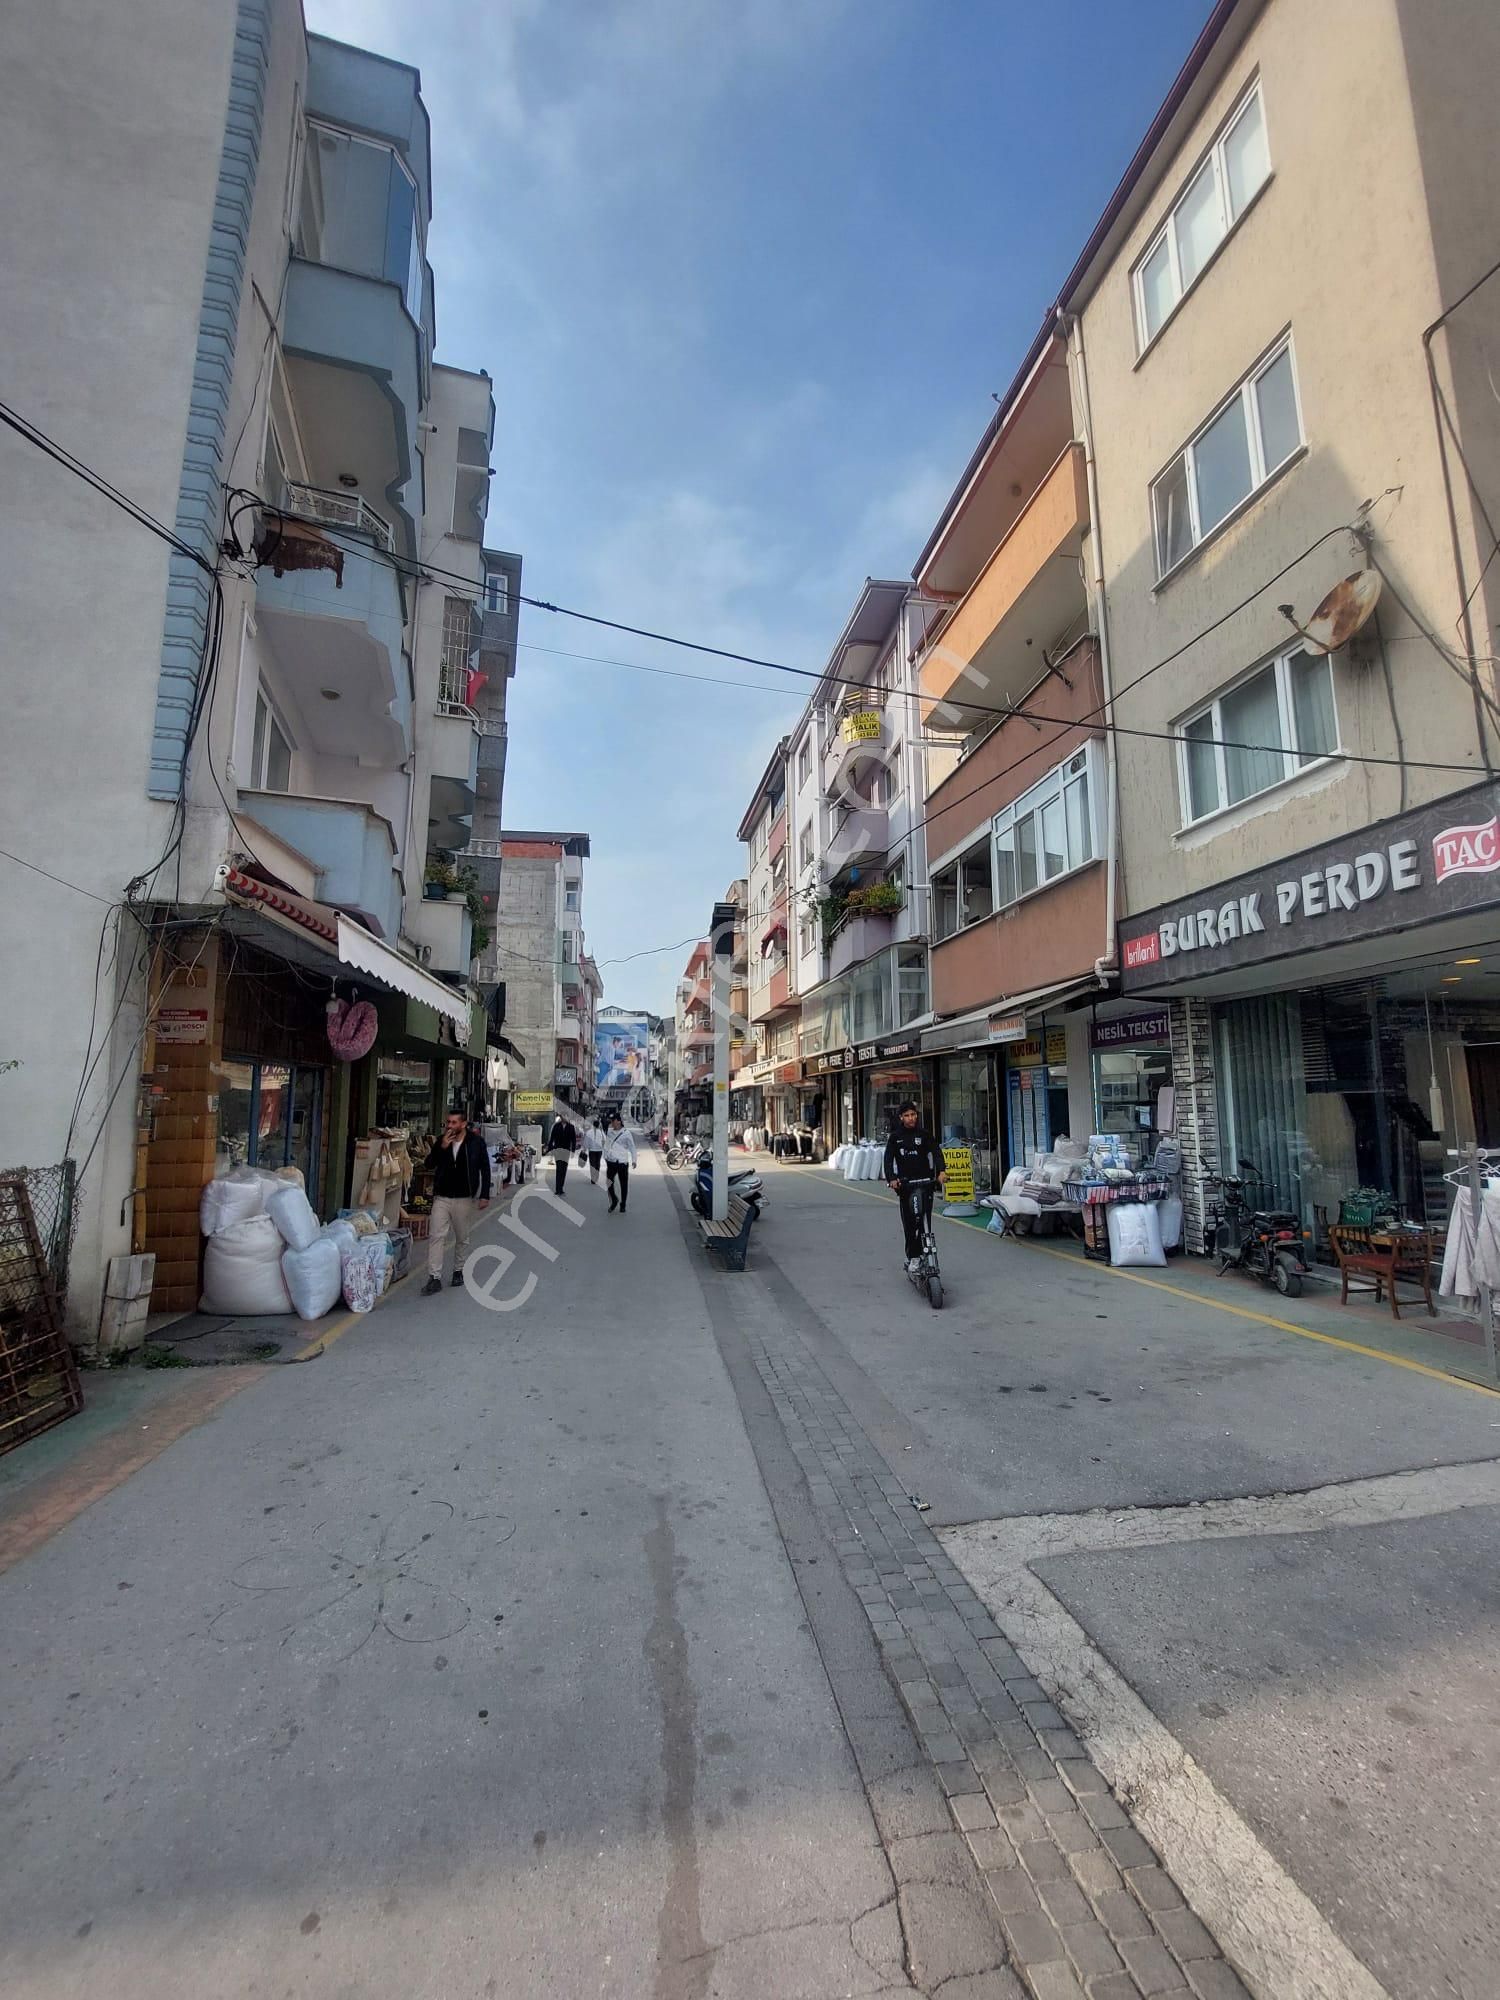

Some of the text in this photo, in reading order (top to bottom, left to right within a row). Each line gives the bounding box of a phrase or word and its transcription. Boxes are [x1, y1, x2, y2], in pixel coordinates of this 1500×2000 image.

[1437, 828, 1496, 871] TAÇ
[1159, 839, 1421, 958] BURAK PERDE
[1097, 1015, 1171, 1041] NESİL TEKSTİ
[516, 1093, 551, 1103] Kamelya
[943, 1151, 969, 1159] YILDIZ
[944, 1161, 971, 1170] EMLAK
